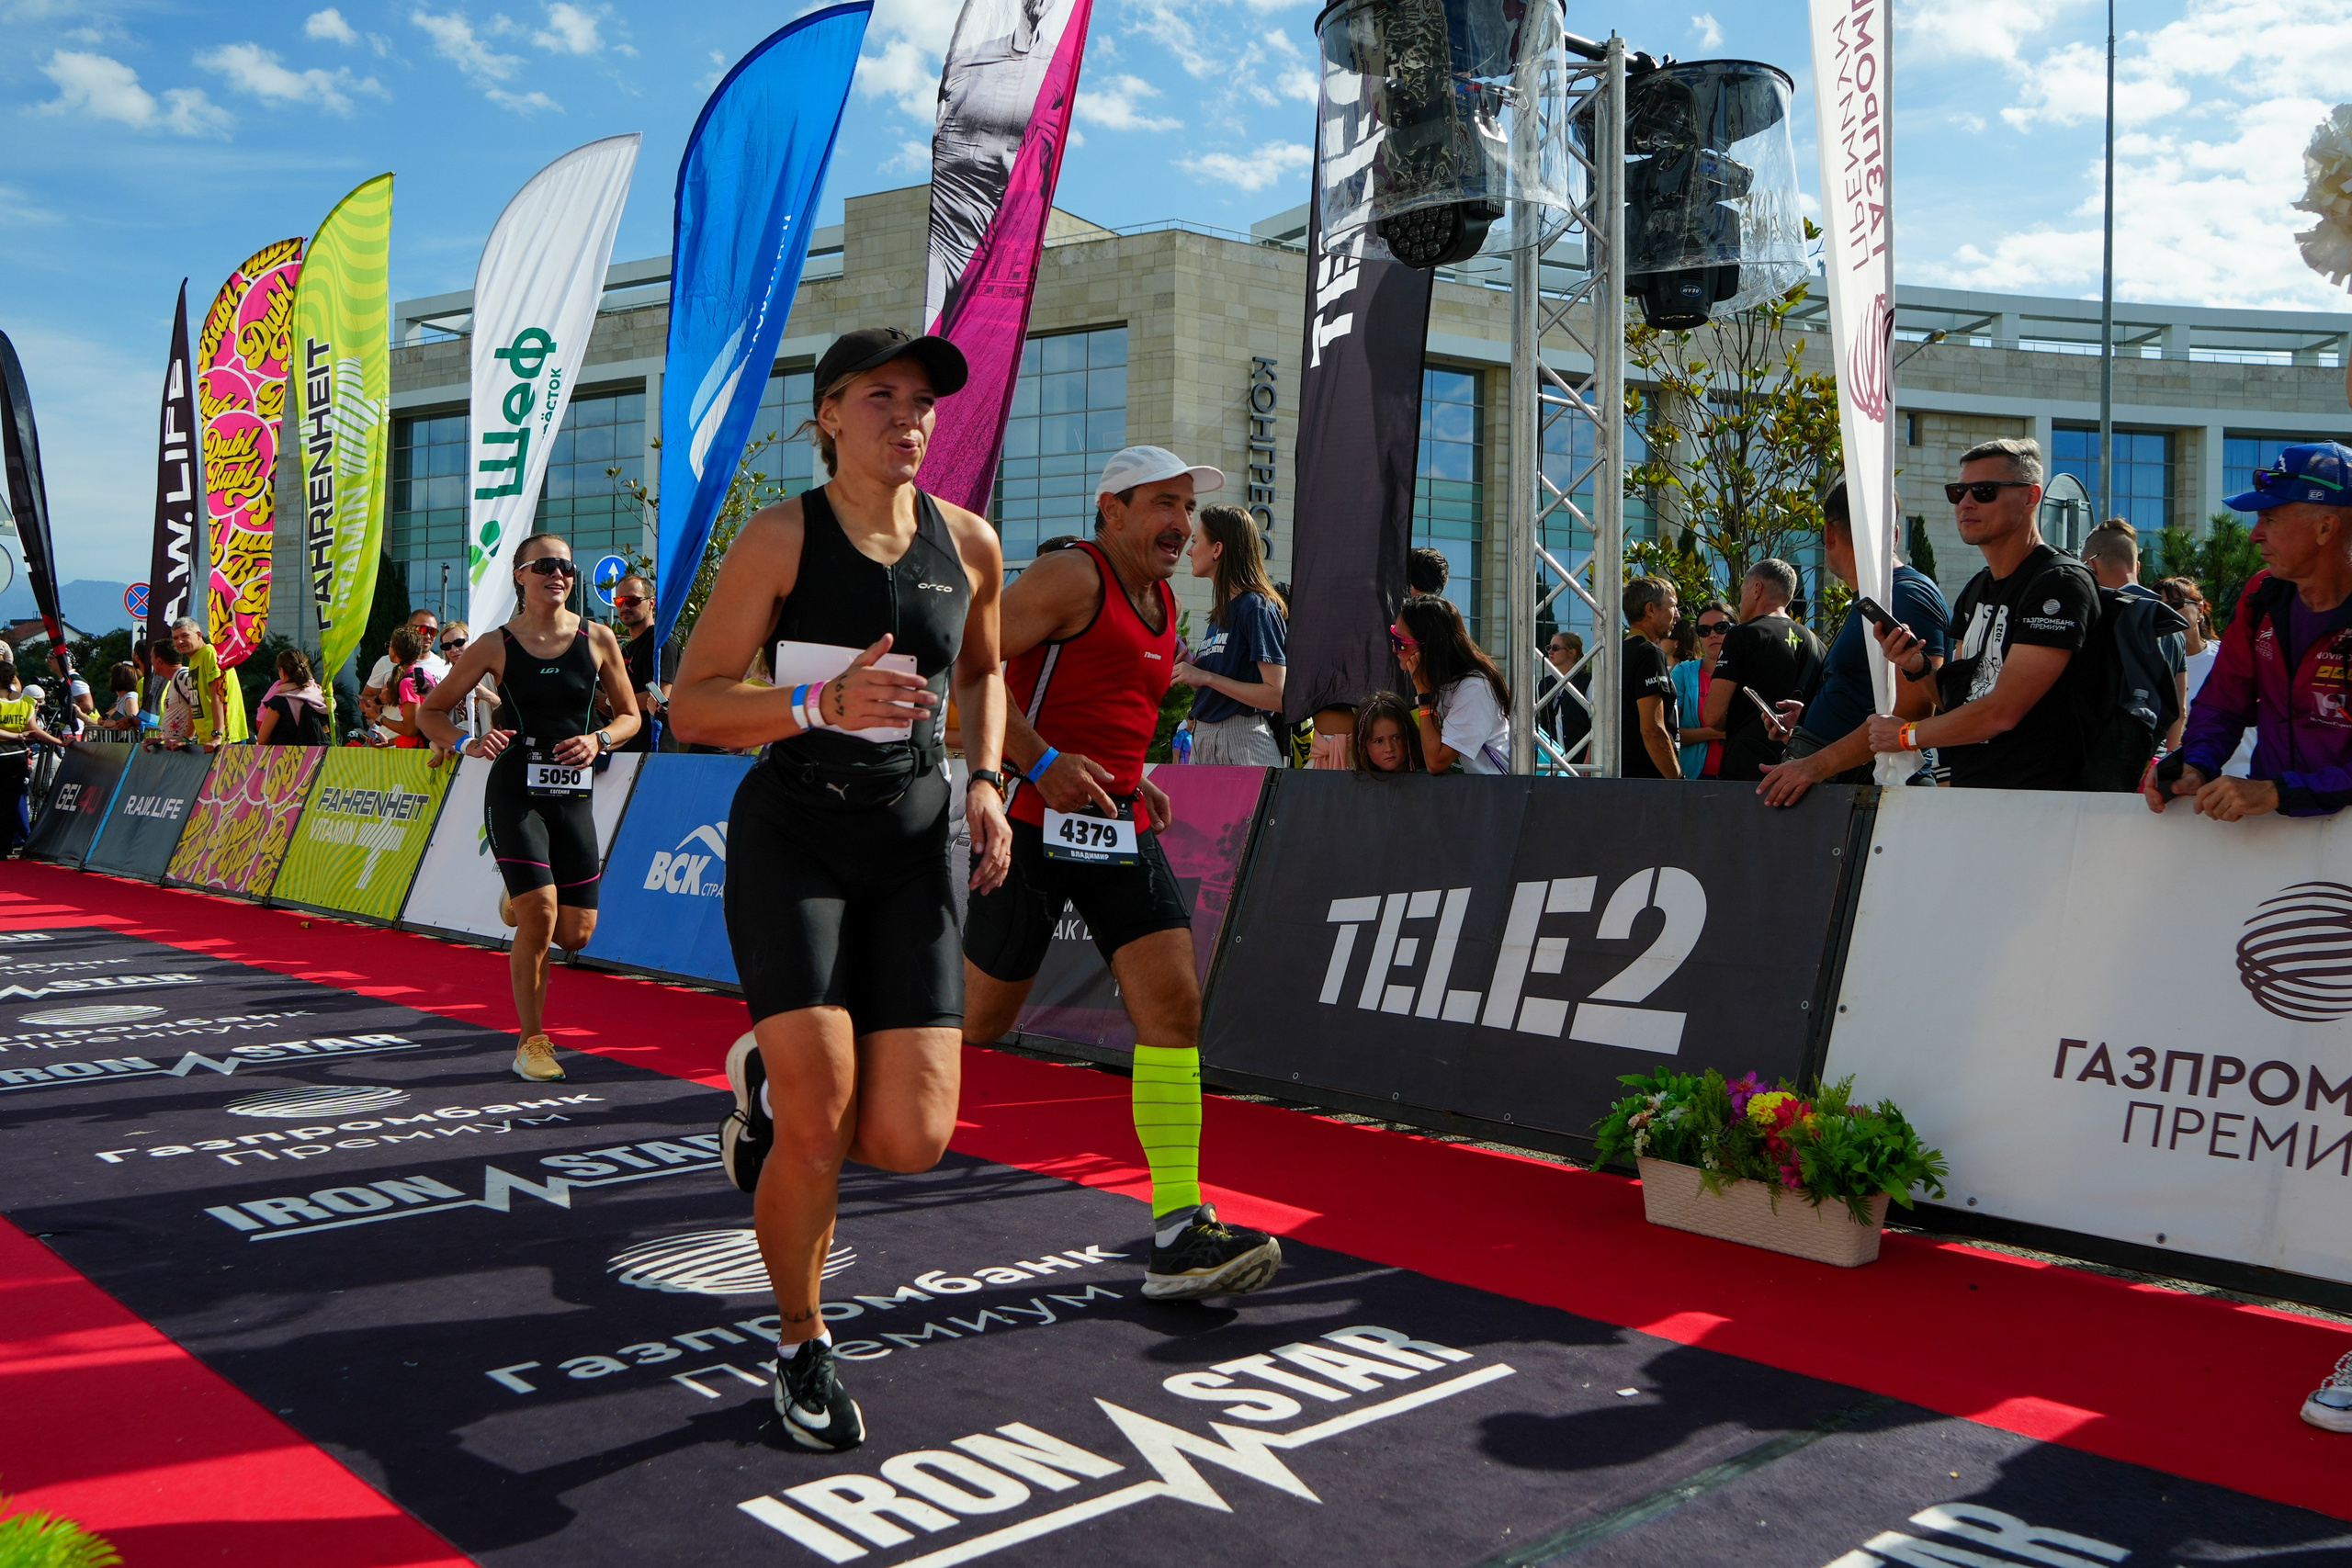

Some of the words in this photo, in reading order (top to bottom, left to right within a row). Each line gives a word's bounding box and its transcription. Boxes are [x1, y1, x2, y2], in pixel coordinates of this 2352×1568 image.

[474, 327, 558, 501] Шеф
[203, 426, 264, 464] Dubl
[164, 358, 193, 627] A.W.LIFE
[207, 458, 266, 507] Bubl
[306, 336, 334, 632] FAHRENHEIT
[340, 485, 368, 618] ITAMIN
[1995, 623, 2004, 643] 2023
[2022, 617, 2075, 627] ГАЗПРОМБАНК
[2030, 623, 2066, 632] ПРЕМИУМ
[538, 768, 582, 785] 5050
[316, 786, 430, 821] FAHRENHEIT
[310, 817, 359, 845] VITAMIN
[1059, 818, 1118, 848] 4379
[1070, 850, 1110, 861] ВЛАДИМИР
[643, 851, 712, 896] ВСК
[701, 882, 725, 897] СТРА
[48, 973, 198, 989] STAR
[1318, 866, 1708, 1055] TELE2
[0, 1056, 161, 1084] RON
[231, 1033, 413, 1059] STAR
[2052, 1037, 2352, 1117] ГАЗПРОМ
[95, 1093, 606, 1165] Газпромбанк
[217, 1113, 572, 1167] Премиум
[2122, 1100, 2352, 1177] ПРЕМИ
[204, 1175, 466, 1232] IRON
[671, 1284, 1123, 1399] Пемиум
[737, 1422, 1126, 1565] IRON
[1163, 1325, 1474, 1423] STAR
